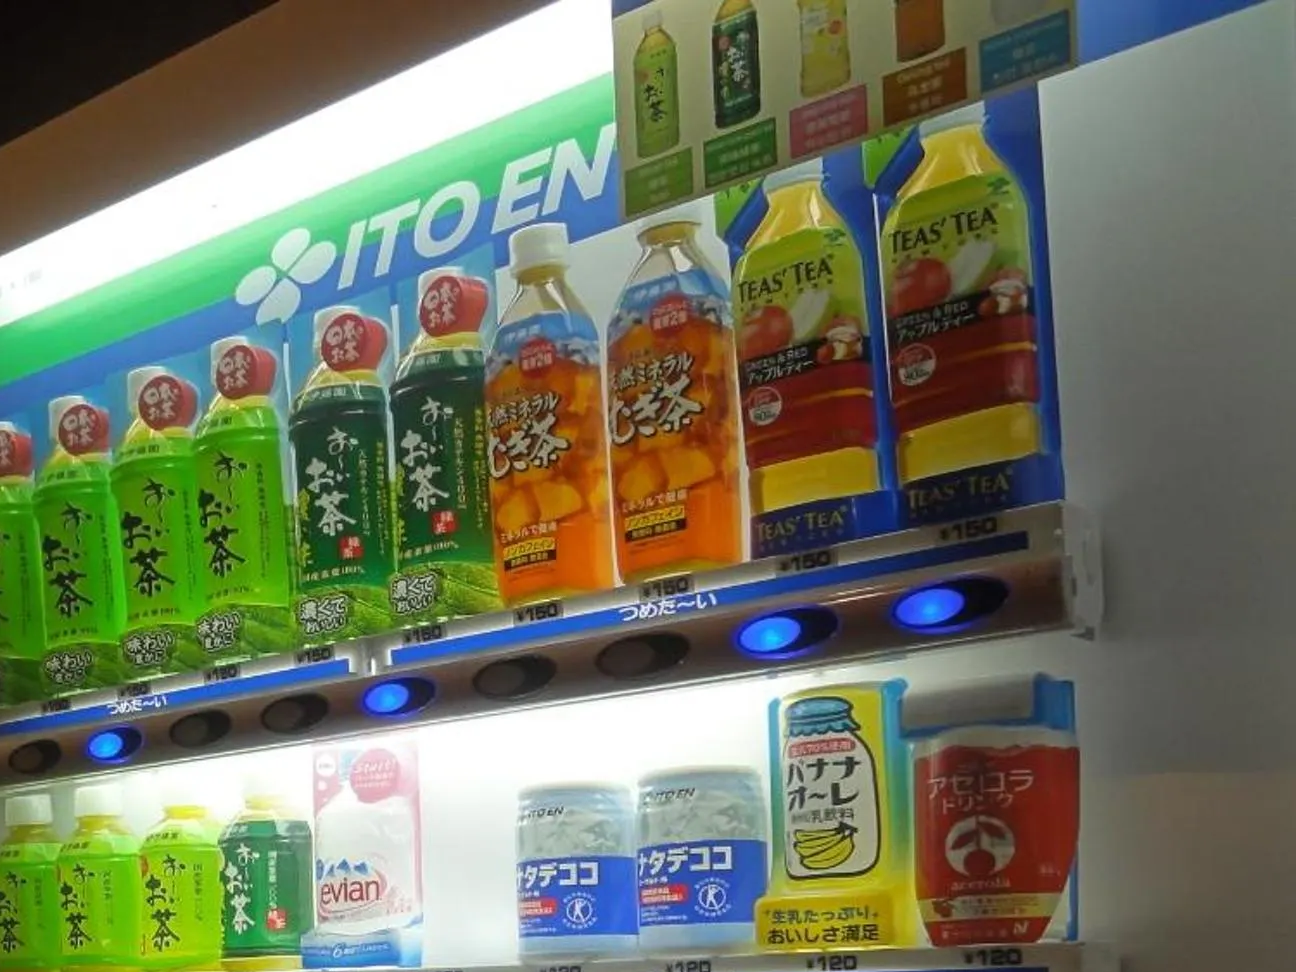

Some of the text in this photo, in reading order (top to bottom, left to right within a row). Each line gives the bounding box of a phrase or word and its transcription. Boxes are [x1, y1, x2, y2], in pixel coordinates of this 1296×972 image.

[338, 180, 481, 290] ITO
[492, 124, 616, 233] EN
[888, 206, 997, 254] TEAS' TEA
[736, 258, 833, 303] TEAS' TEA
[401, 430, 450, 512] お茶
[305, 457, 356, 536] お茶
[198, 489, 246, 577] お茶
[939, 517, 997, 541] ¥150
[121, 511, 175, 597] お茶
[787, 756, 862, 787] バナナ
[927, 769, 1034, 799] アセロラ
[517, 861, 599, 888] ナタデココ
[638, 846, 732, 877] ナタデココ
[145, 874, 181, 952] お茶
[223, 862, 255, 934] お茶
[321, 877, 380, 904] evian
[59, 881, 92, 949] お茶
[767, 924, 879, 945] おいしさ満足
[806, 955, 858, 971] ¥120
[963, 948, 1023, 966] ¥120
